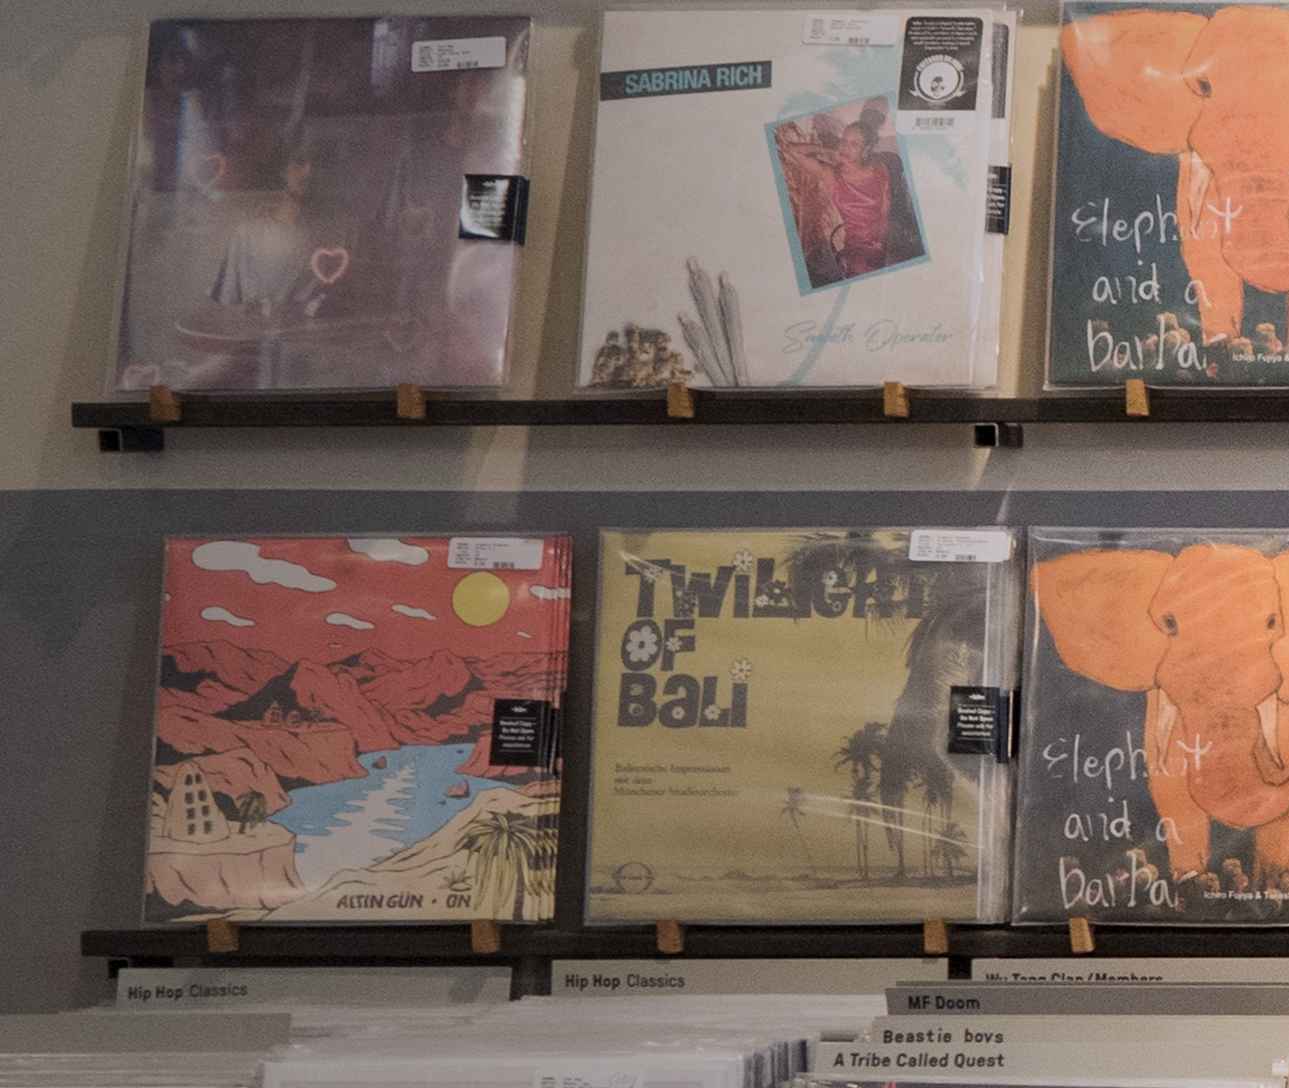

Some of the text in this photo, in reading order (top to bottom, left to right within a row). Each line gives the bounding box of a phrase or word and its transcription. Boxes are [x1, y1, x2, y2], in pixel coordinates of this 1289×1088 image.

[625, 64, 763, 95] SABRINA RICH
[1092, 262, 1212, 312] and a
[621, 618, 696, 673] OF
[1063, 797, 1184, 846] and a
[386, 889, 423, 909] GÜN
[564, 973, 686, 990] Hip Hop Classics
[128, 983, 249, 1001] Hip Hop Classics
[907, 996, 981, 1011] MF Doom
[882, 1028, 953, 1044] Beastie
[833, 1053, 1005, 1070] A Tribe Called Quest
